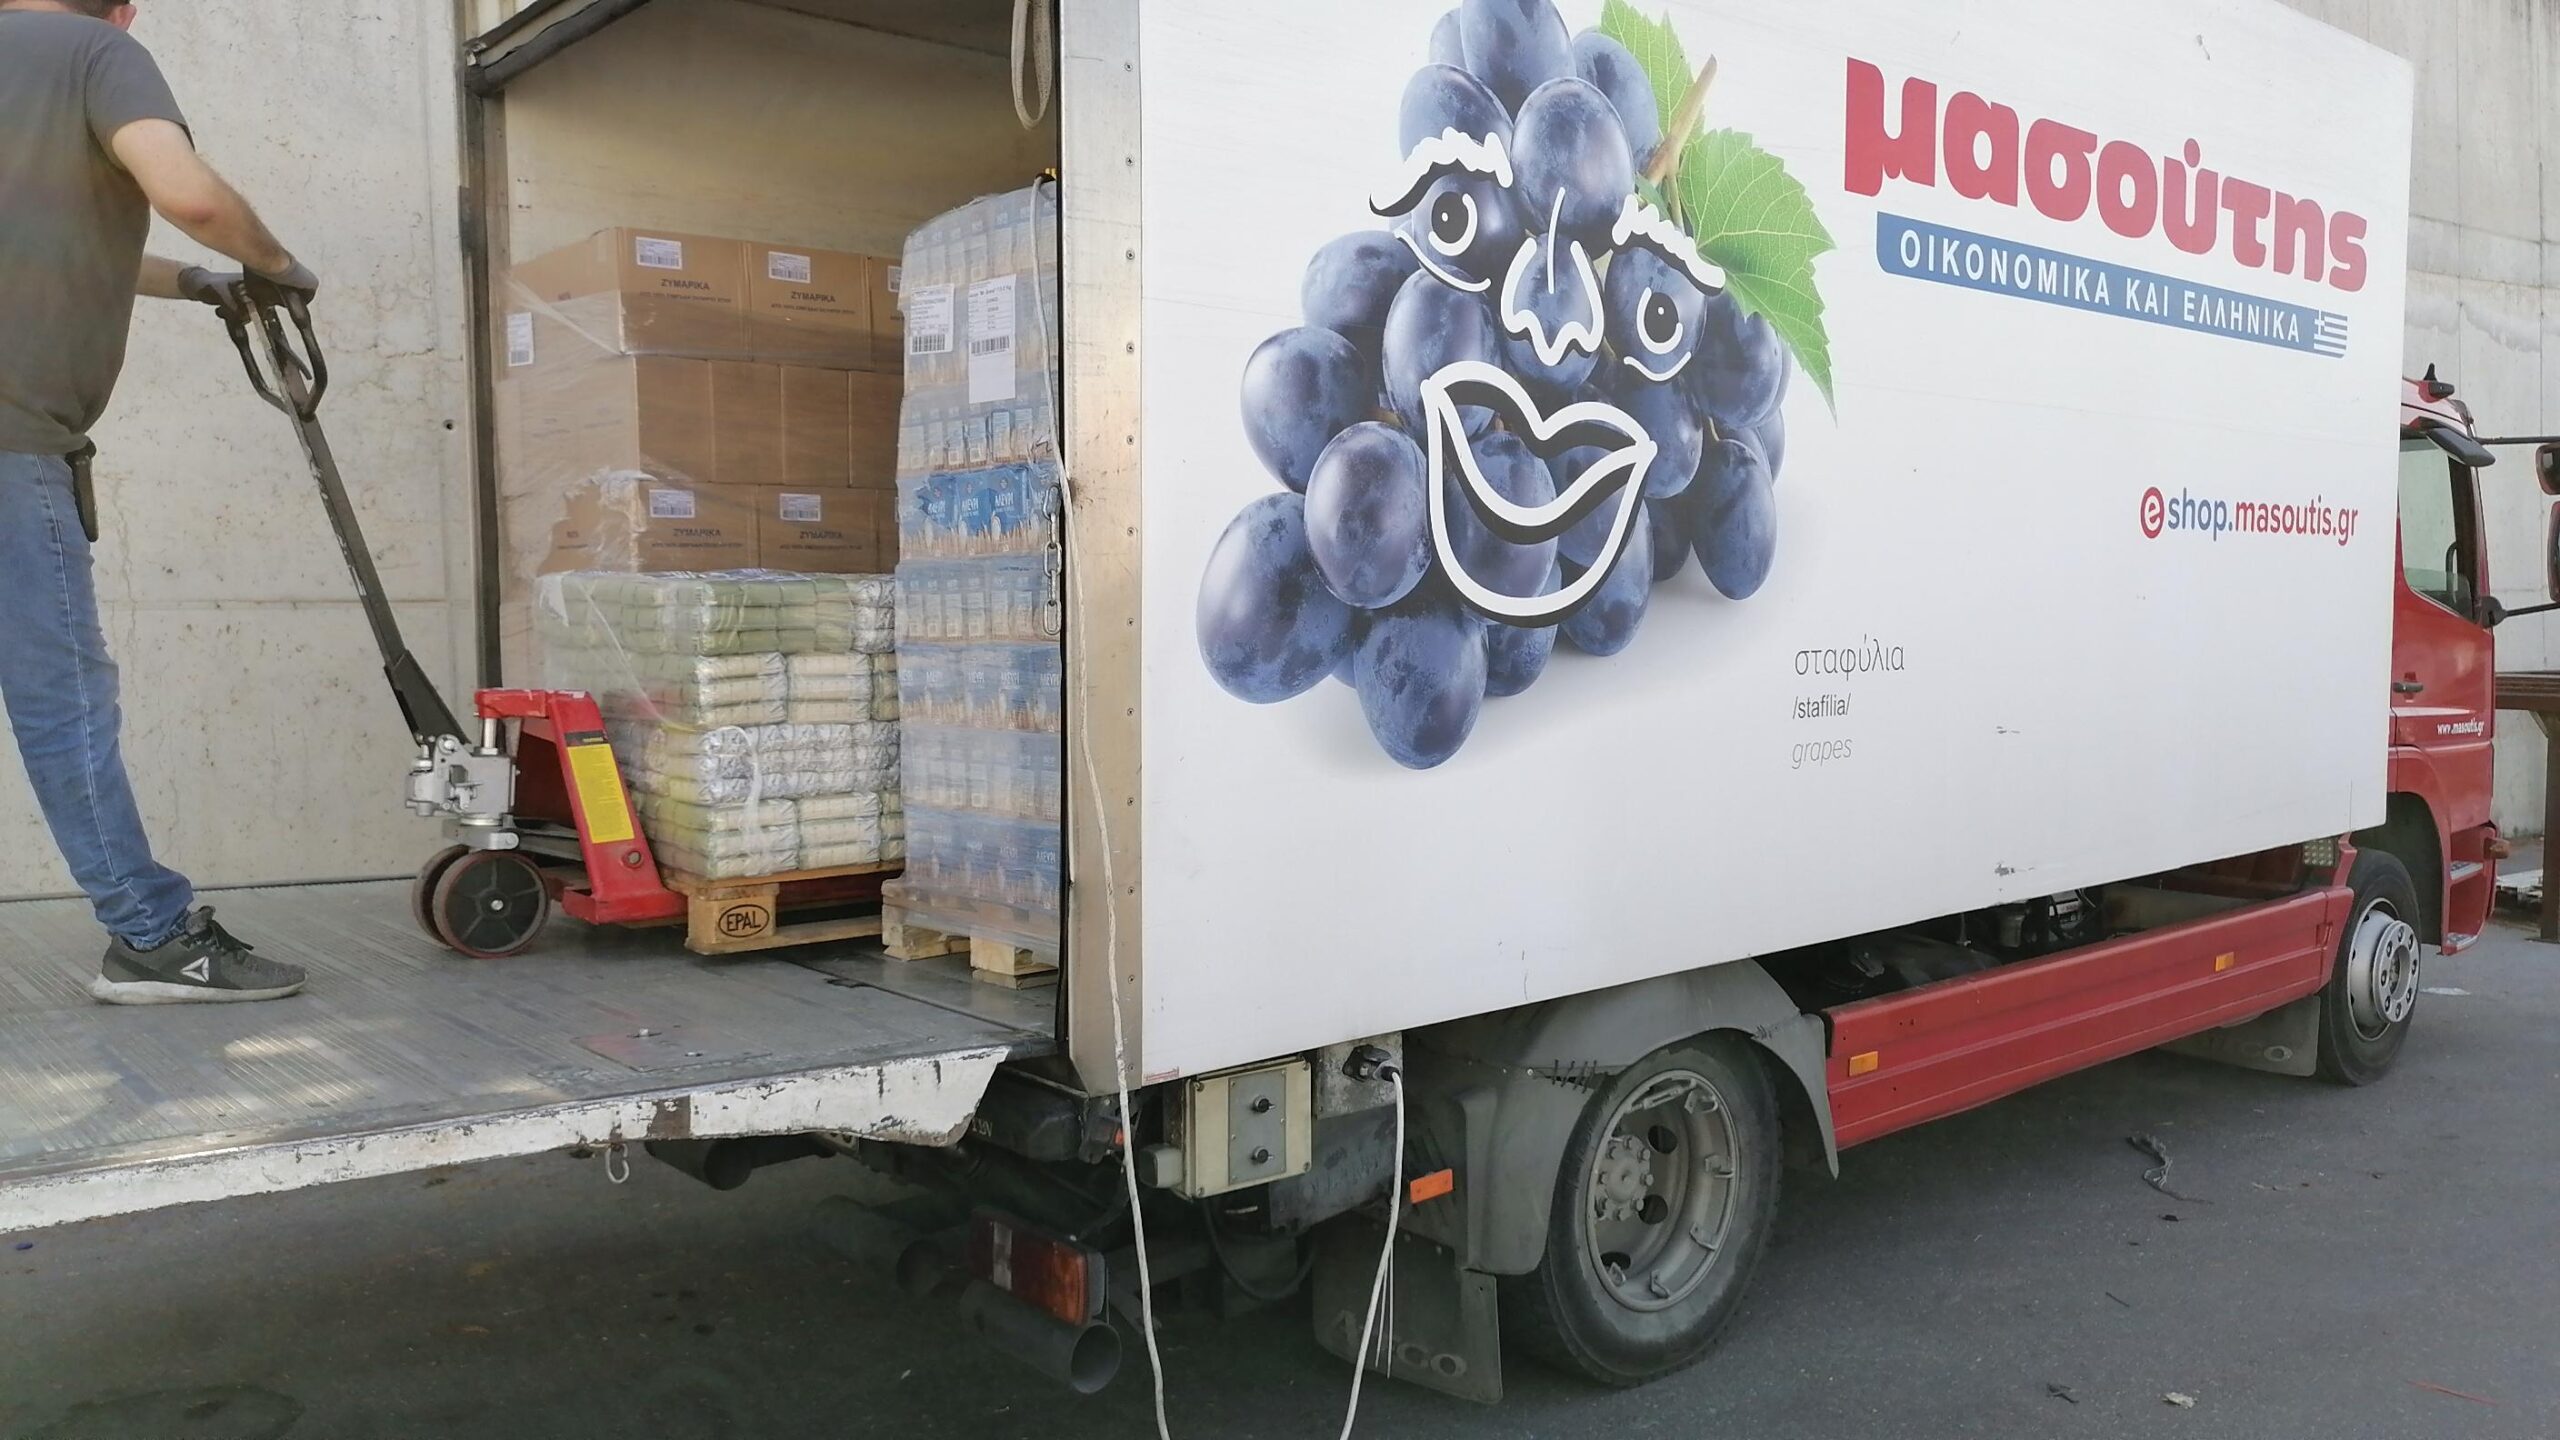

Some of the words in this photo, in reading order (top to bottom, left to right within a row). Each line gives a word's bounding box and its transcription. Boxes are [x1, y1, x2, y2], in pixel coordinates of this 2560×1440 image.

[1900, 229, 2110, 306] ΟΙΚΟΝΟΜΙΚΑ
[2125, 279, 2169, 317] ΚΑΙ
[2184, 290, 2301, 343] ΕΛΛΗΝΙΚΑ
[1795, 633, 1905, 681] σταφύλια
[1791, 738, 1853, 769] grapes
[727, 911, 762, 932] EPAL
